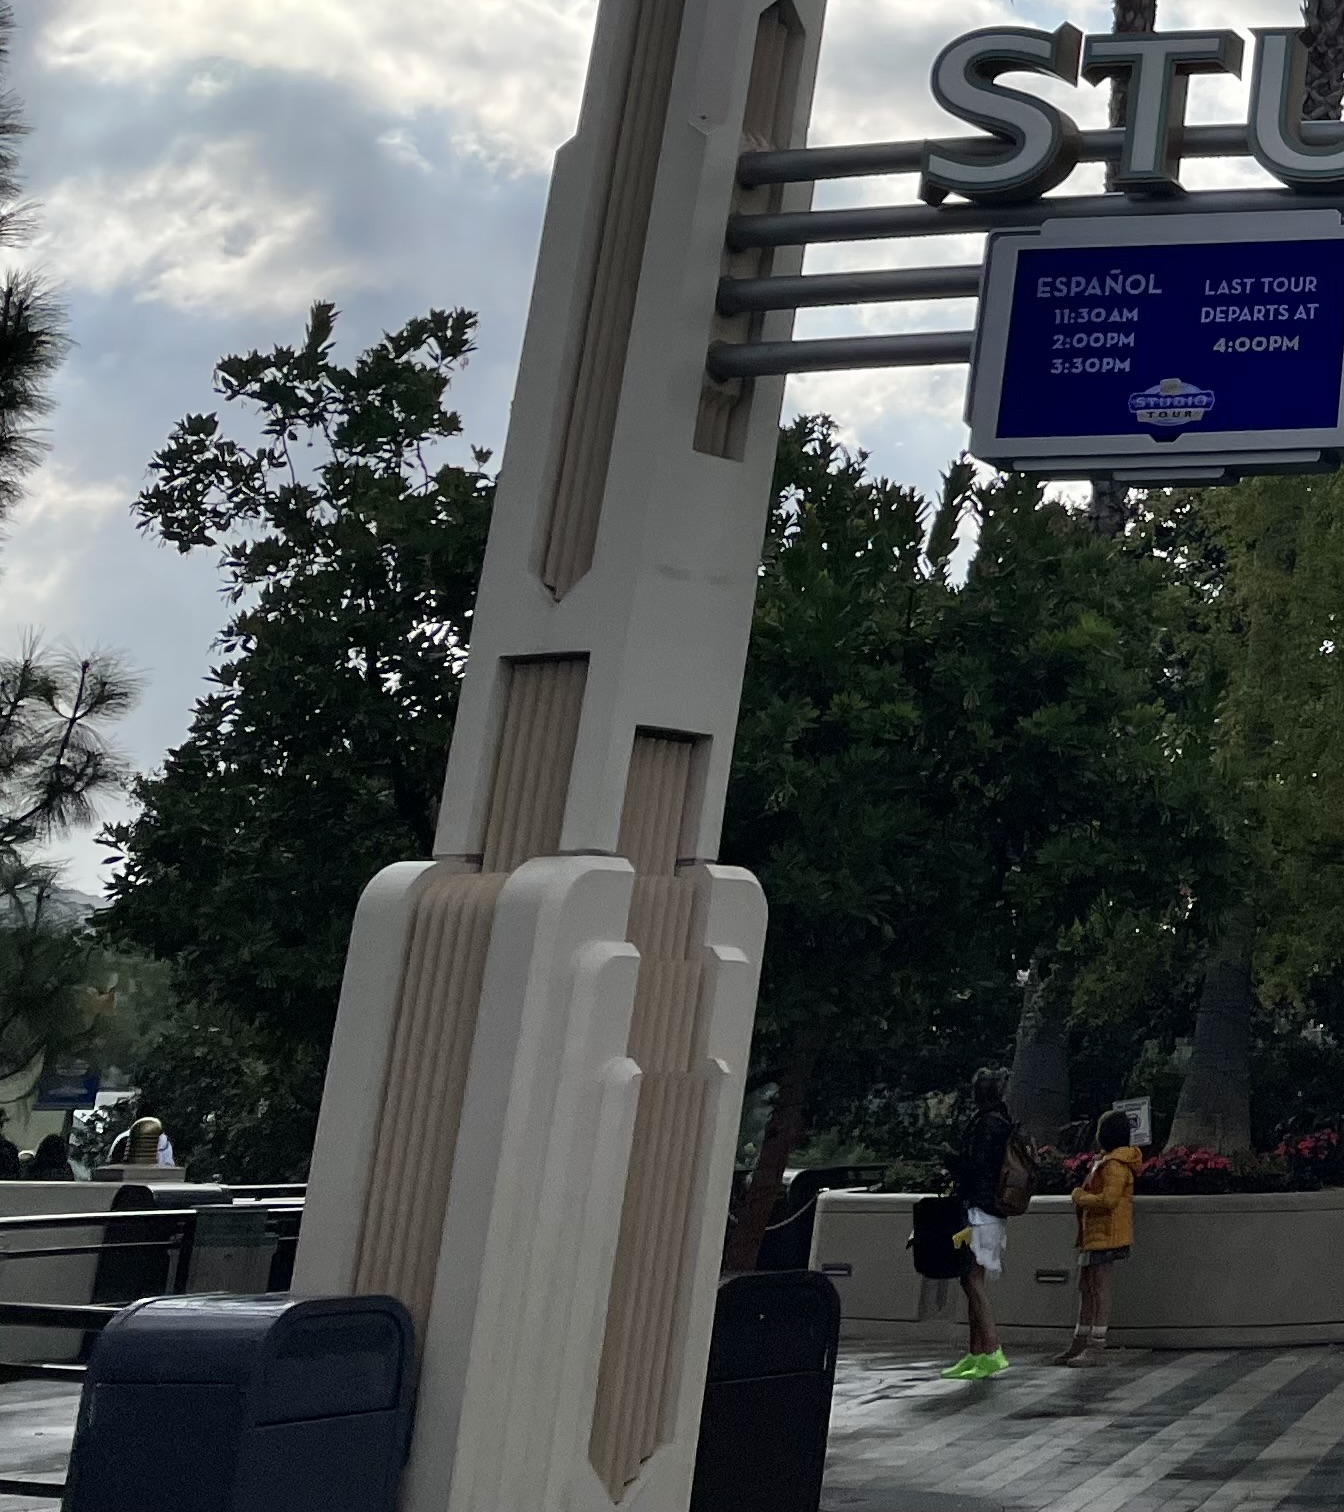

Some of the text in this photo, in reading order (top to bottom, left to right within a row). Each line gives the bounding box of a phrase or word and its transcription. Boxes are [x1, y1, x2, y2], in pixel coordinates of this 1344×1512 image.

[1036, 269, 1163, 299] ESPAÑOL
[1204, 276, 1318, 296] LAST TOUR
[1054, 307, 1139, 324] 11:30AM
[1200, 304, 1319, 323] DEPARTS AT
[1052, 333, 1135, 350] 2:00PM
[1213, 335, 1300, 353] 4:00PM
[1050, 358, 1131, 374] 3:30PM
[1135, 394, 1208, 408] STUDIO
[1146, 410, 1192, 419] TOUR
